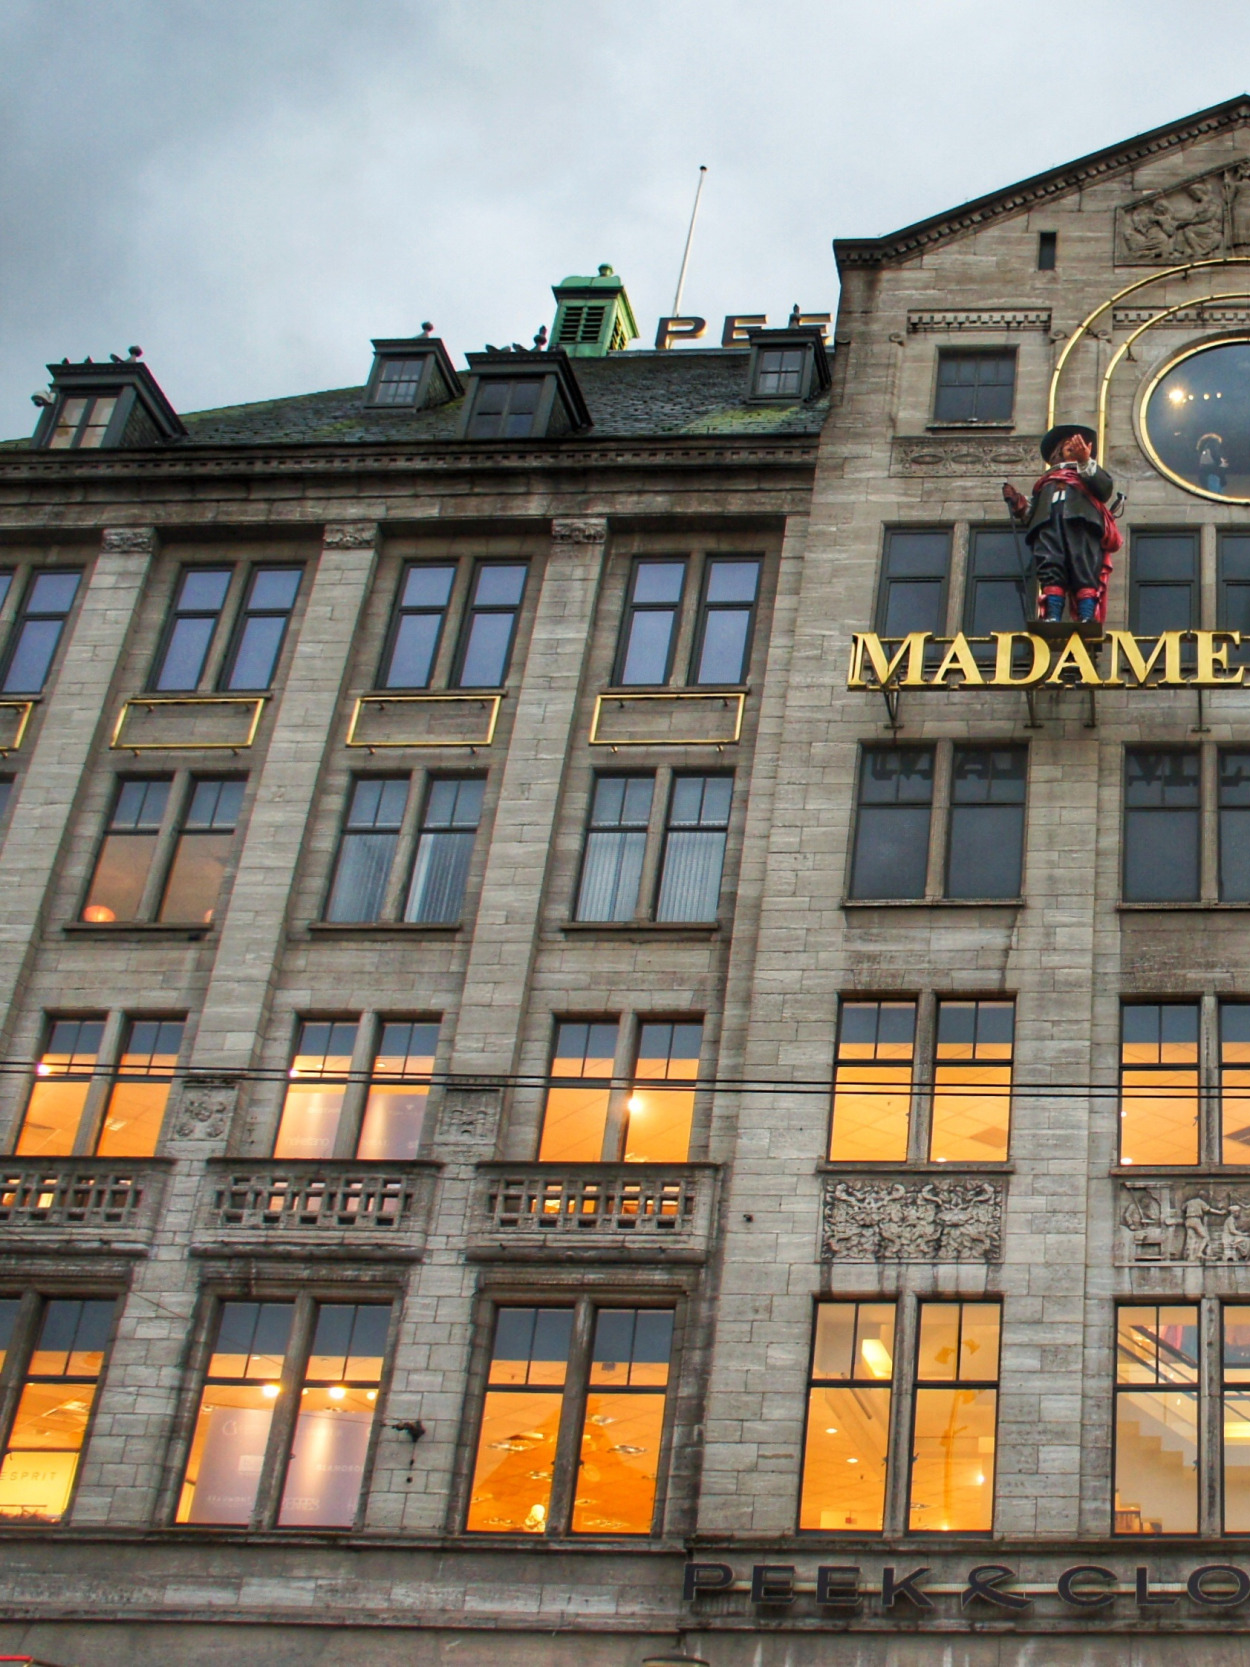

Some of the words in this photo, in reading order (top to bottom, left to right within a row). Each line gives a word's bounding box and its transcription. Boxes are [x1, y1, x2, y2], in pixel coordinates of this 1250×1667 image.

[848, 631, 1246, 690] MADAME
[1, 1471, 57, 1481] ESPRIT
[682, 1562, 934, 1607] PEEK
[962, 1564, 1033, 1609] &
